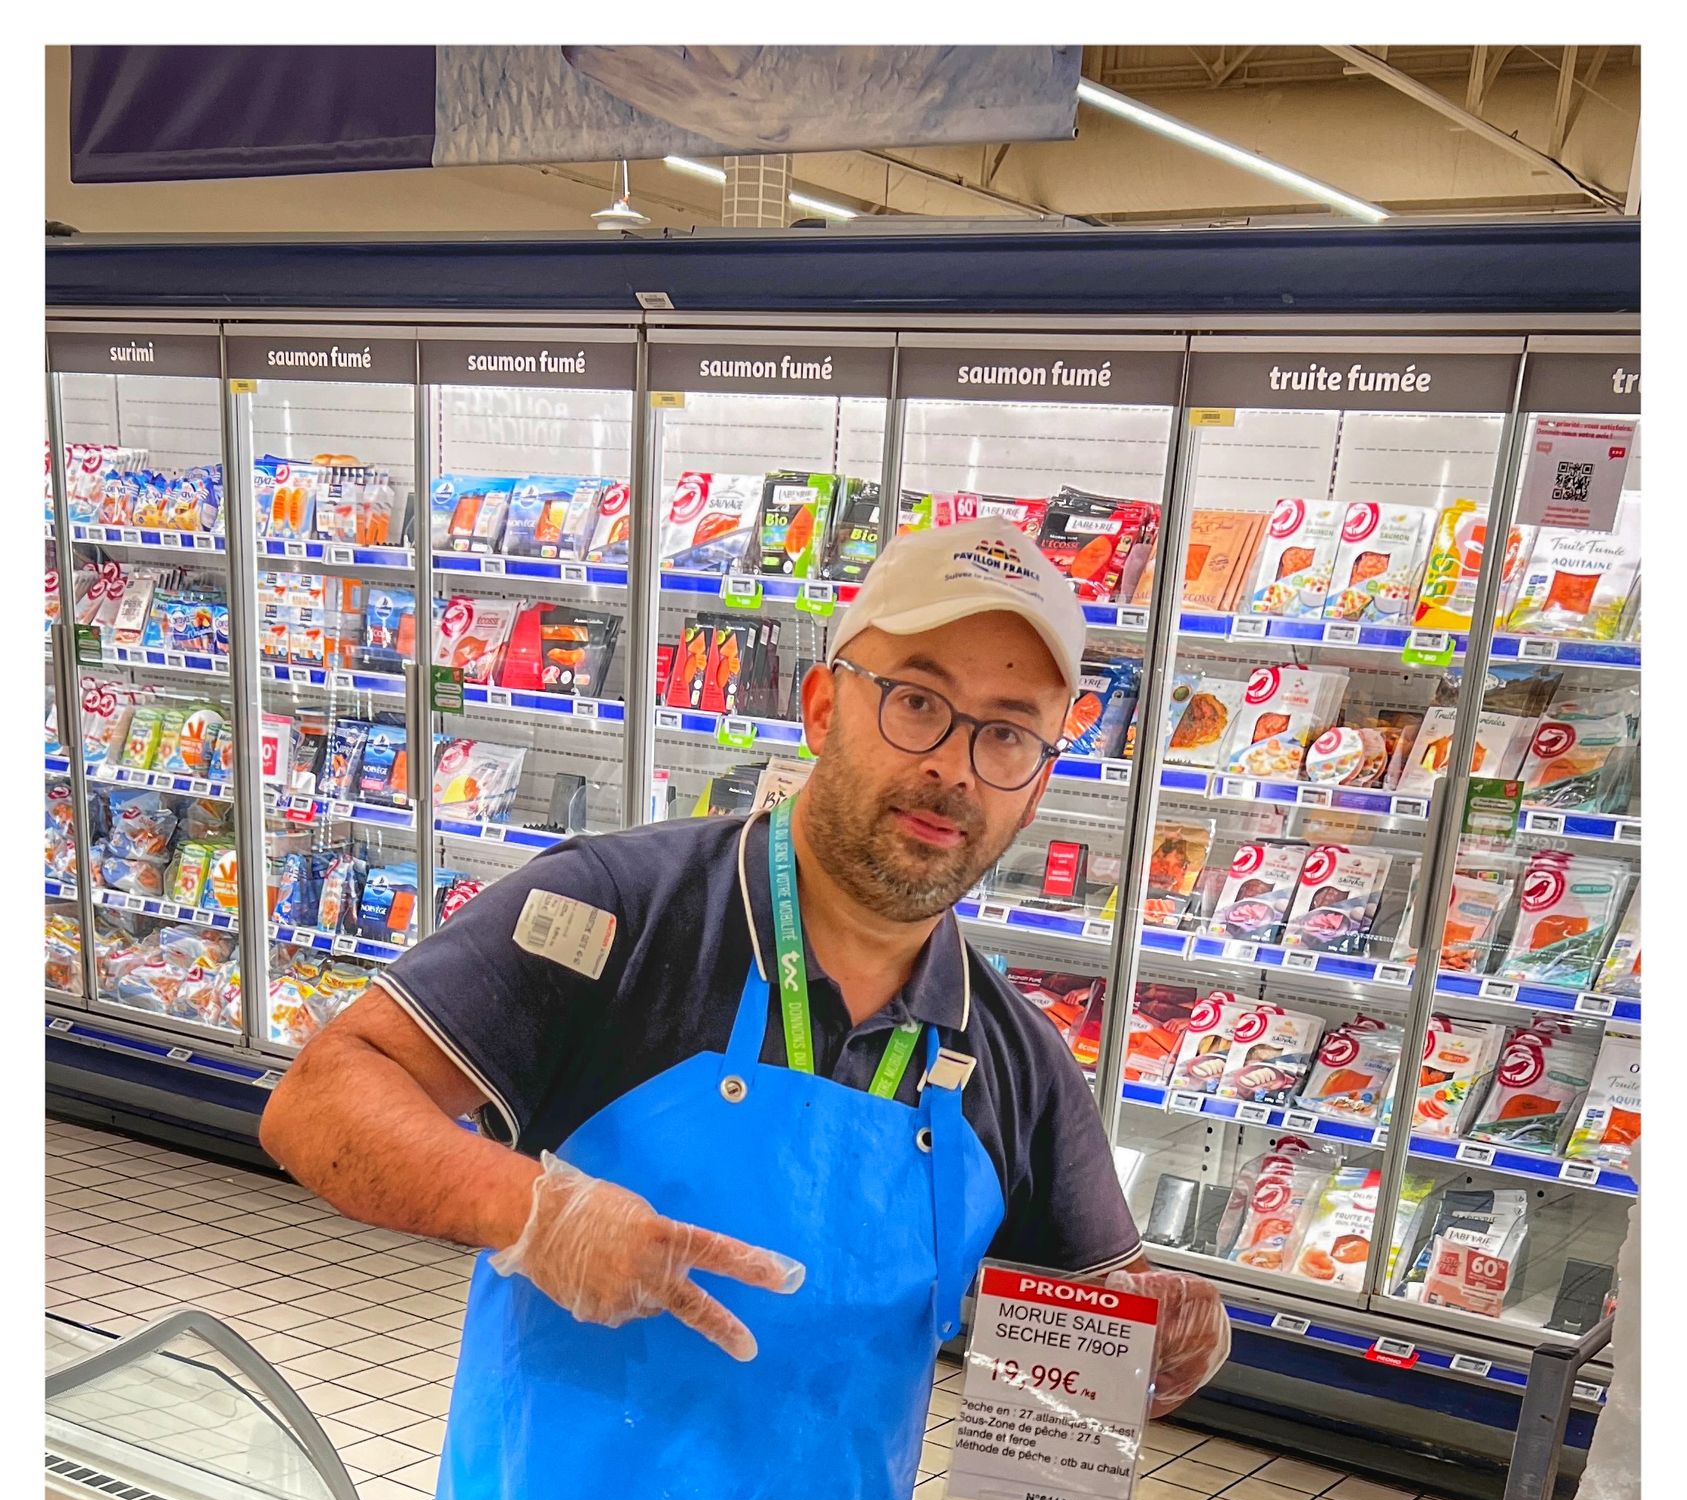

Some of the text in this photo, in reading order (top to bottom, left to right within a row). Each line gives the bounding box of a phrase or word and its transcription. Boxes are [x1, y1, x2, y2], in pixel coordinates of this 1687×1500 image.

[110, 342, 154, 362] surimi
[268, 347, 371, 368] saumon fumé
[467, 351, 585, 373] saumon fumé
[700, 355, 832, 380] saumon fumé
[957, 361, 1111, 386] saumon fumé
[1270, 364, 1431, 392] truite fumée
[766, 513, 788, 526] Bio
[851, 529, 878, 542] Bio
[953, 552, 1000, 568] PAVILLON
[1552, 558, 1613, 570] AQUITAINE
[779, 900, 797, 942] MOBILITÉ
[1449, 1230, 1491, 1245] LABEYRIE
[1019, 1278, 1120, 1309] PROMO
[999, 1303, 1132, 1340] MORUE SALEE
[995, 1323, 1071, 1349] SECHEE
[1376, 1354, 1401, 1365] PROMO
[996, 1407, 1010, 1416] en
[996, 1432, 1007, 1442] et
[1009, 1434, 1037, 1448] feroe
[1019, 1422, 1032, 1433] de
[1035, 1425, 1067, 1440] pêche
[1002, 1446, 1016, 1458] de
[1018, 1449, 1051, 1464] pêche
[1060, 1457, 1077, 1468] otb
[1080, 1462, 1094, 1471] au
[1097, 1463, 1130, 1477] chalut
